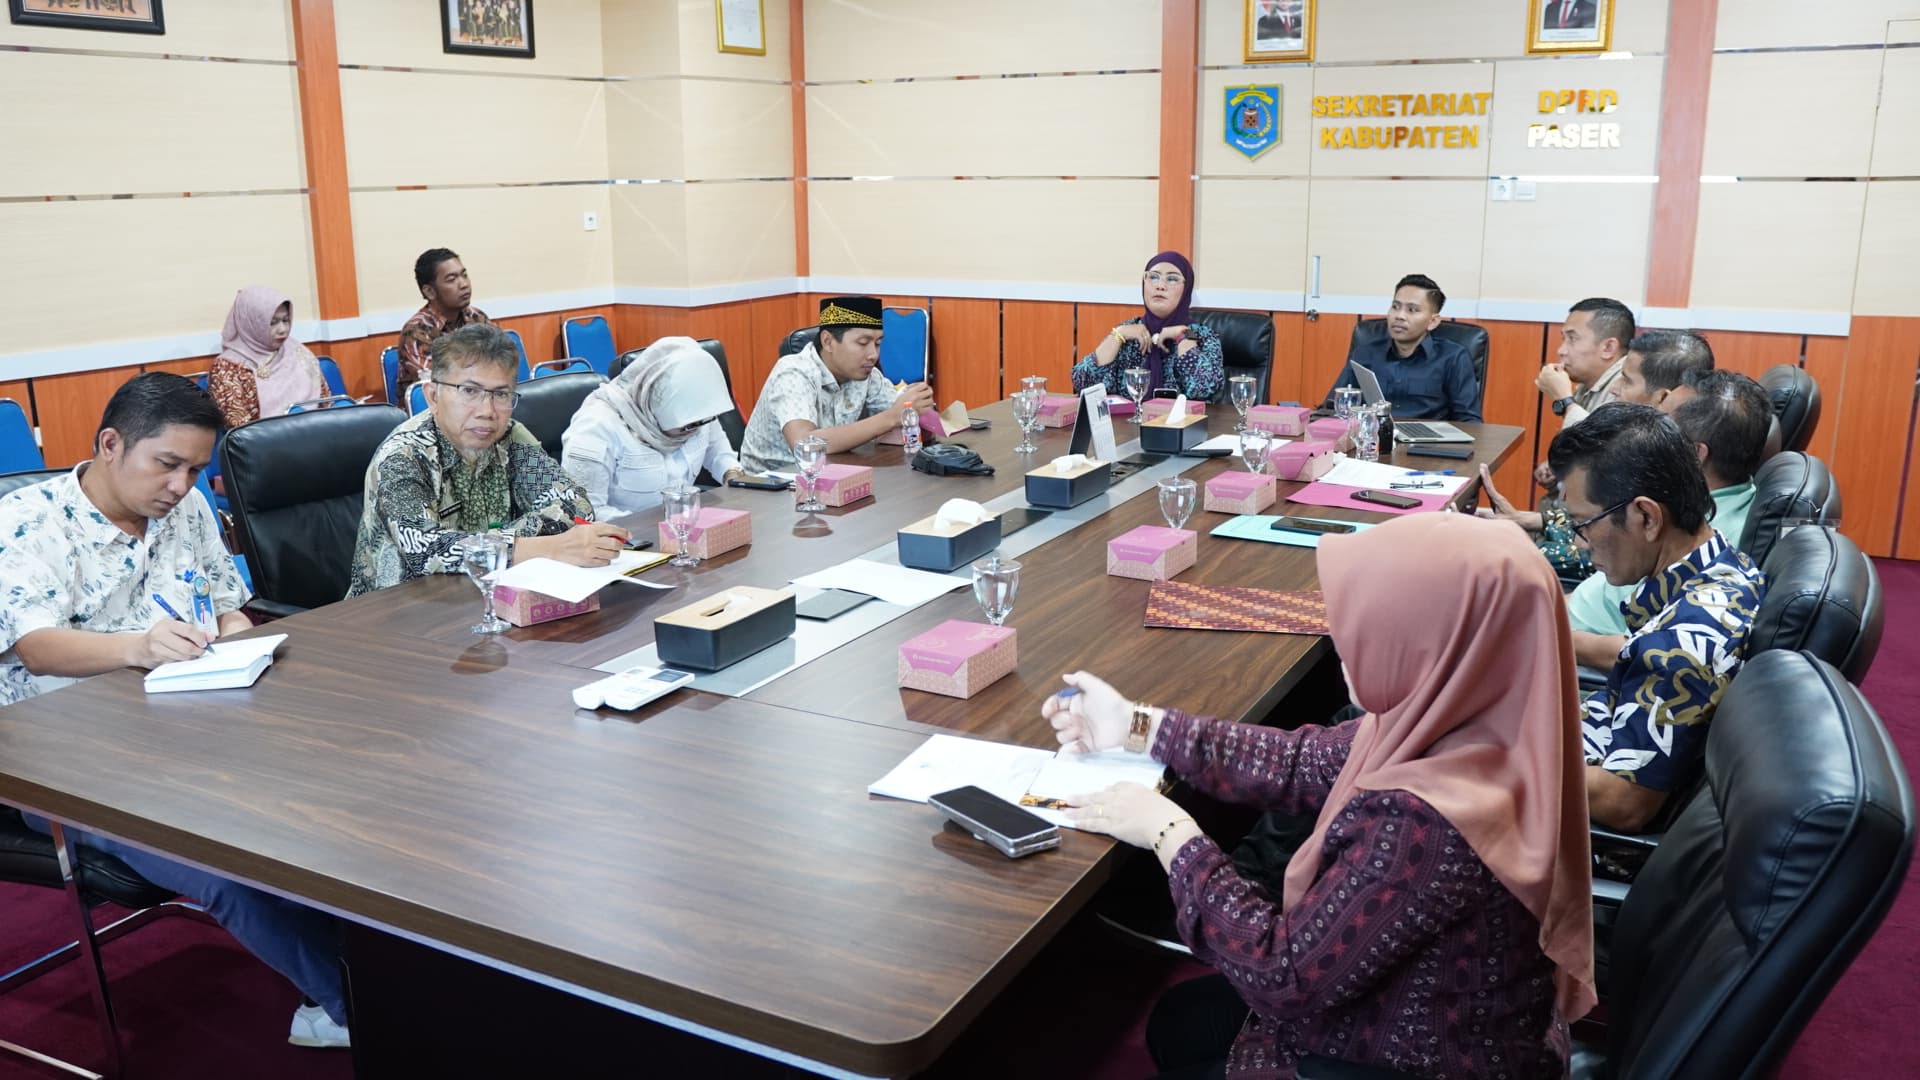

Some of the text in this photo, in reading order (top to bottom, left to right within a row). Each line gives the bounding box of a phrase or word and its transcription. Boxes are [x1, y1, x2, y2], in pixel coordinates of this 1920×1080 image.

[1312, 89, 1618, 117] SEKRETARIAT DPRD
[1320, 122, 1620, 149] KABUPATEN PASER
